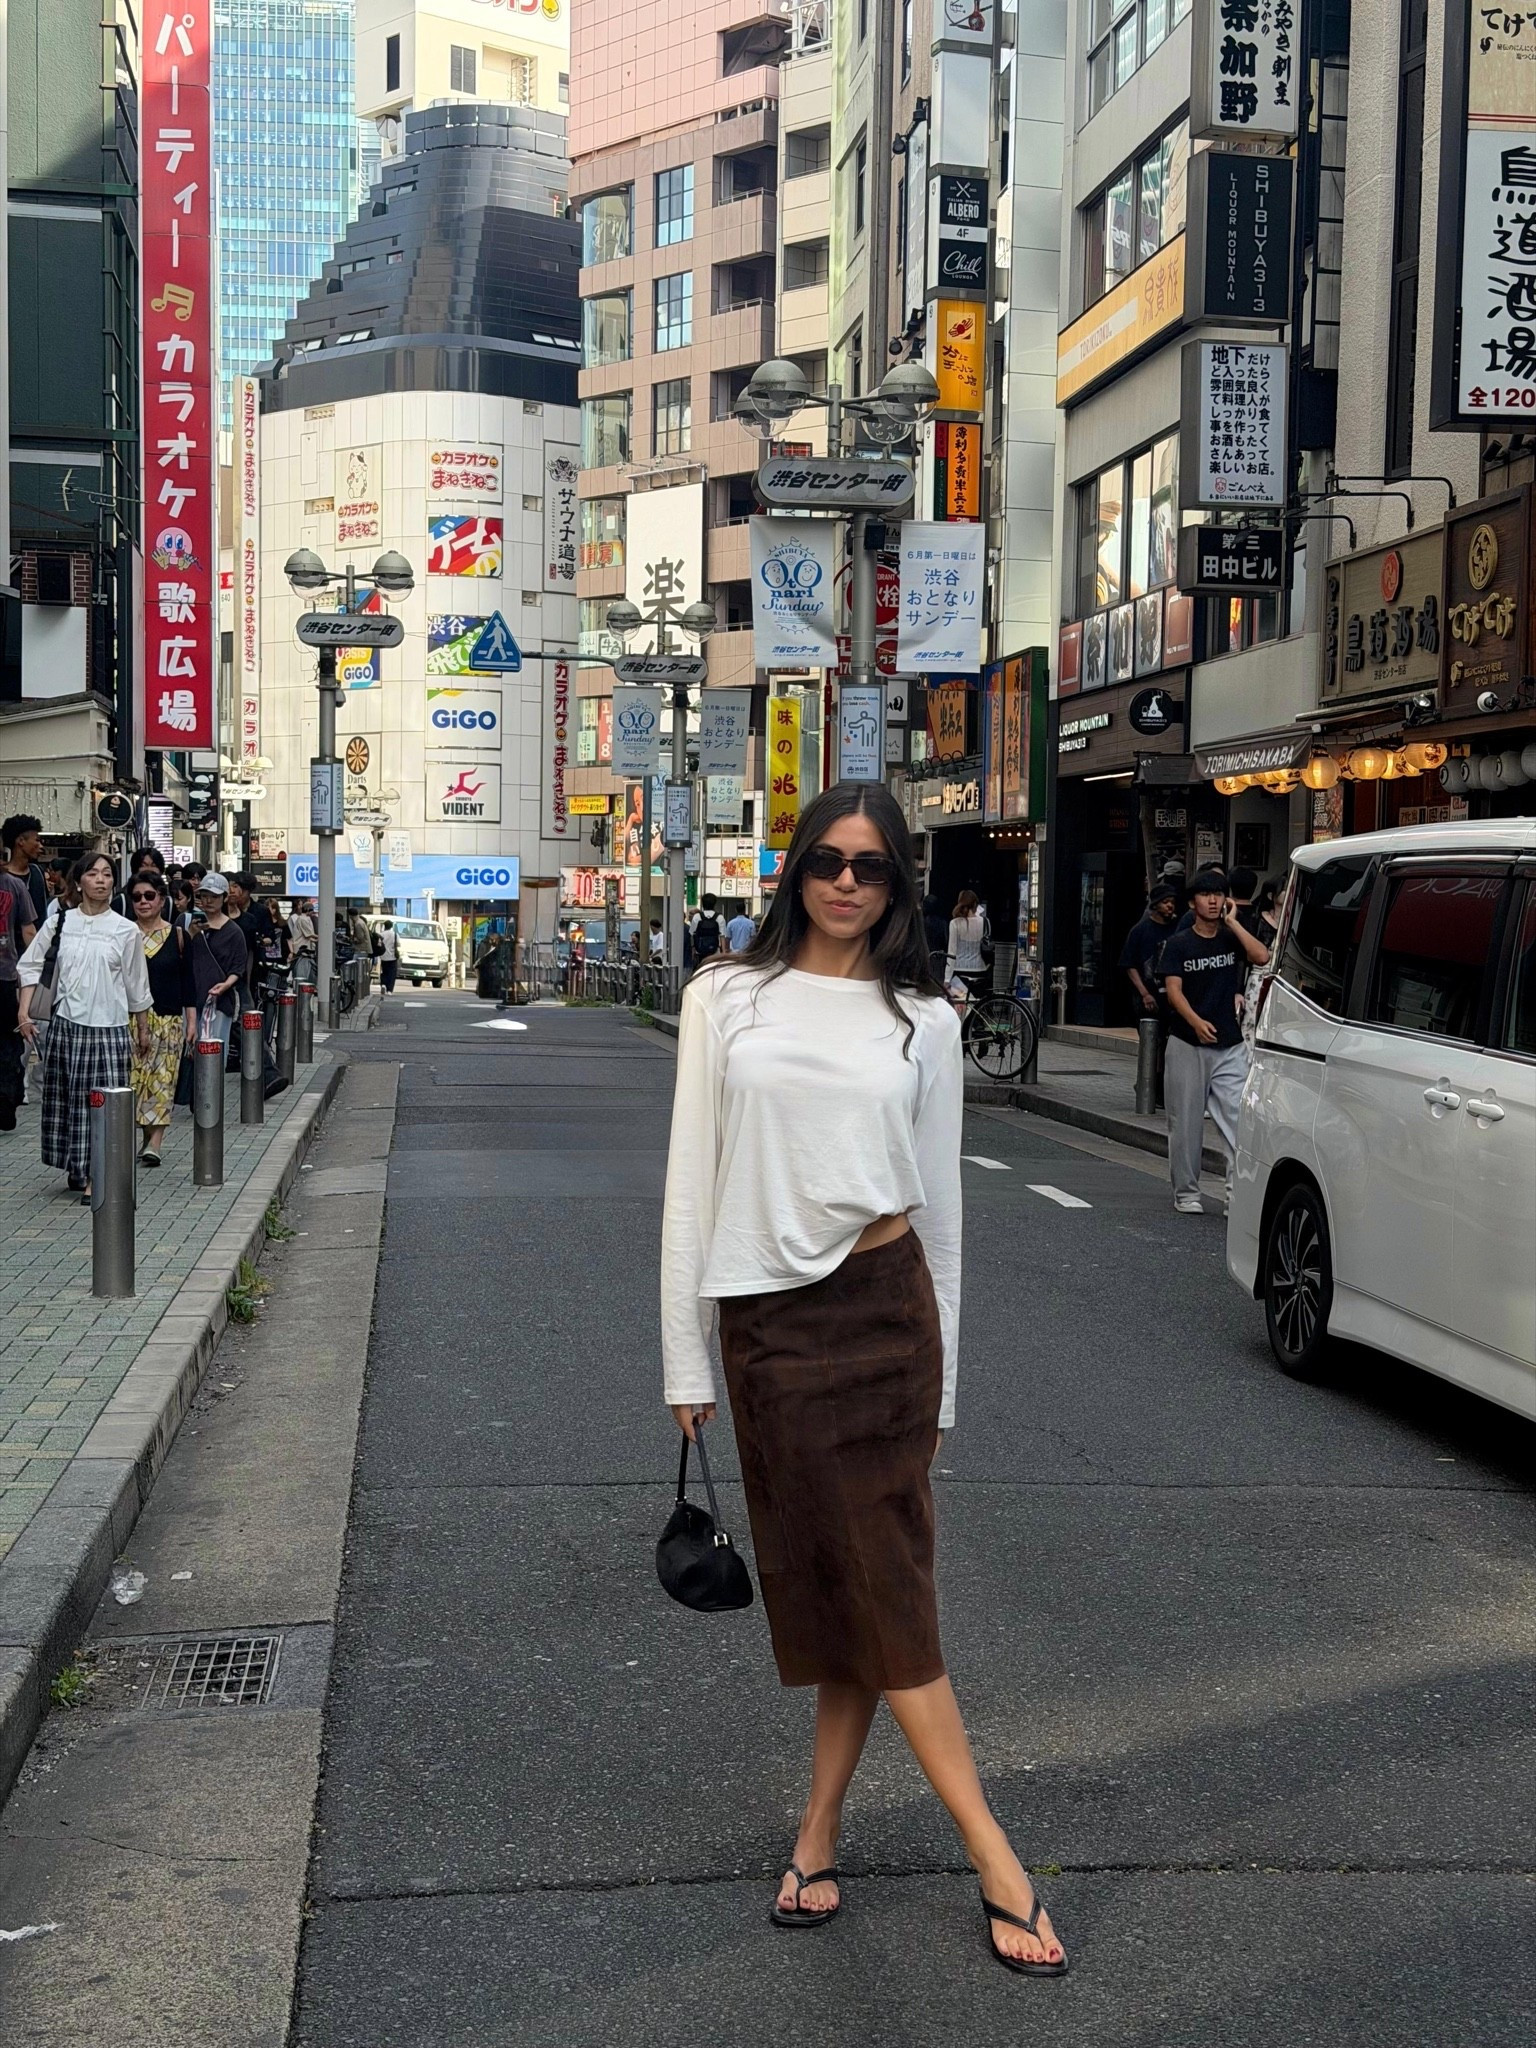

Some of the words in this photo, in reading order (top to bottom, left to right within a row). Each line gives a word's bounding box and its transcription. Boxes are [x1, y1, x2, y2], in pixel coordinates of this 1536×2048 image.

[152, 12, 196, 268] パーティー
[1229, 172, 1238, 225] LIQUOR
[947, 202, 980, 219] ALBERO
[956, 228, 970, 239] 4F
[1253, 165, 1269, 312] SHIBUYA313
[943, 250, 983, 278] Chill
[1227, 230, 1237, 301] MOUNTAIN
[1211, 345, 1270, 366] 地下だけ
[1211, 365, 1270, 379] ど入ったら
[1210, 379, 1270, 394] 雰囲気良く
[1210, 393, 1270, 407] て料理人が
[1211, 406, 1270, 421] しっかり食
[157, 334, 197, 518] カラオケ
[1210, 419, 1270, 433] 事を作って
[1210, 433, 1269, 448] お酒もたく
[440, 452, 490, 468] カラオケ
[1210, 447, 1269, 461] さんあって
[1209, 461, 1275, 476] 楽しいお店。
[431, 468, 499, 492] まねきねこ
[767, 469, 908, 492] 渋谷センター街
[1228, 482, 1267, 494] ごんべえ
[343, 502, 373, 517] カラオケ
[557, 488, 577, 581] サウナ道場
[1222, 533, 1260, 549] 第三
[907, 550, 976, 561] 6月第一日曜日は
[1202, 555, 1278, 580] 田中ビル
[924, 568, 960, 587] 渋谷
[770, 586, 815, 598] nari
[906, 590, 976, 607] おとなり
[762, 598, 824, 616] Sunday
[906, 611, 976, 627] サンデー
[1448, 592, 1516, 647] てけてけ
[302, 621, 398, 637] 渋谷センター街
[1345, 594, 1440, 673] 鳥道酒場
[158, 581, 197, 731] 歌広場
[771, 645, 821, 654] 渋谷センター街
[913, 650, 964, 659] 渋谷センター街
[343, 666, 373, 681] GiGO
[621, 661, 702, 675] 渋谷センター街
[554, 663, 569, 726] カラオケ
[431, 708, 498, 731] GiGO
[714, 715, 735, 726] 渋谷
[1059, 721, 1079, 737] LIQUOR
[1079, 713, 1109, 733] MOUNTAIN
[704, 728, 744, 737] おとなり
[704, 739, 744, 749] サンデー
[1204, 744, 1295, 774] TORIMICHISAKABA
[347, 774, 367, 784] Darts
[771, 708, 798, 835] 味の兆楽
[442, 803, 484, 816] VIDENT
[295, 866, 320, 882] GiG
[456, 868, 511, 886] GiGO
[1184, 952, 1236, 973] SUPREME
